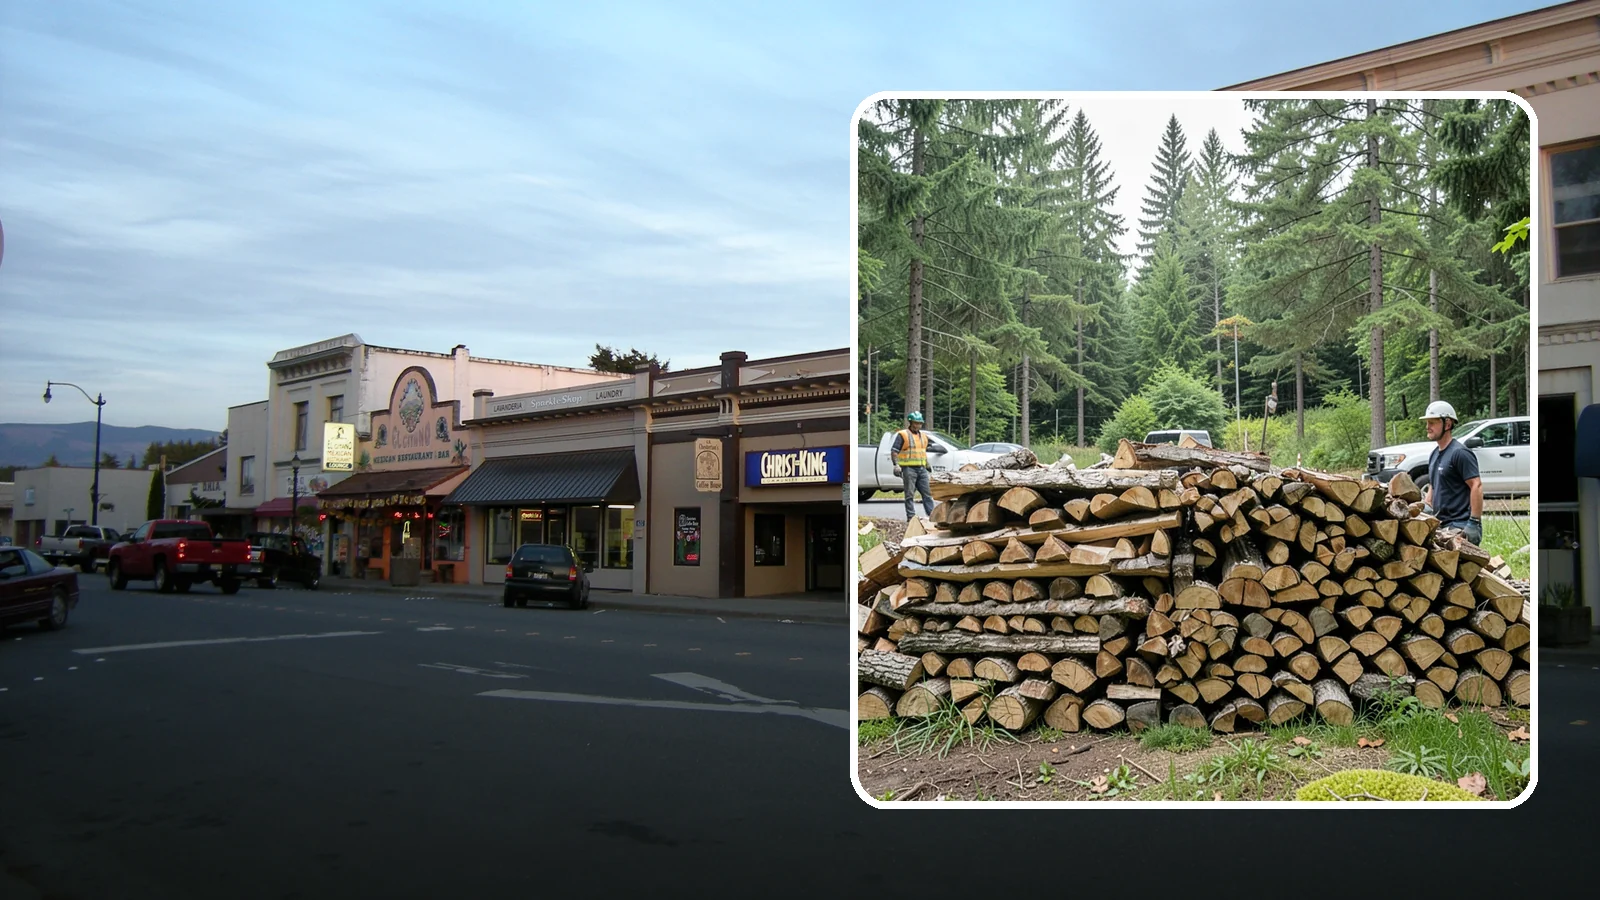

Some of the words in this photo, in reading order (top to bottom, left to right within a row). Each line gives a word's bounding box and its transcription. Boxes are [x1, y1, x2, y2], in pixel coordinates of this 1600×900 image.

[530, 397, 560, 409] Sparkle
[562, 394, 582, 405] Shop
[595, 389, 624, 400] LAUNDRY
[493, 402, 523, 412] LAVANDERIA
[373, 454, 396, 464] MEXICAN
[397, 451, 434, 462] RESTAURANT
[438, 450, 450, 459] BAR
[761, 452, 797, 478] CHRIST
[799, 450, 827, 476] KING
